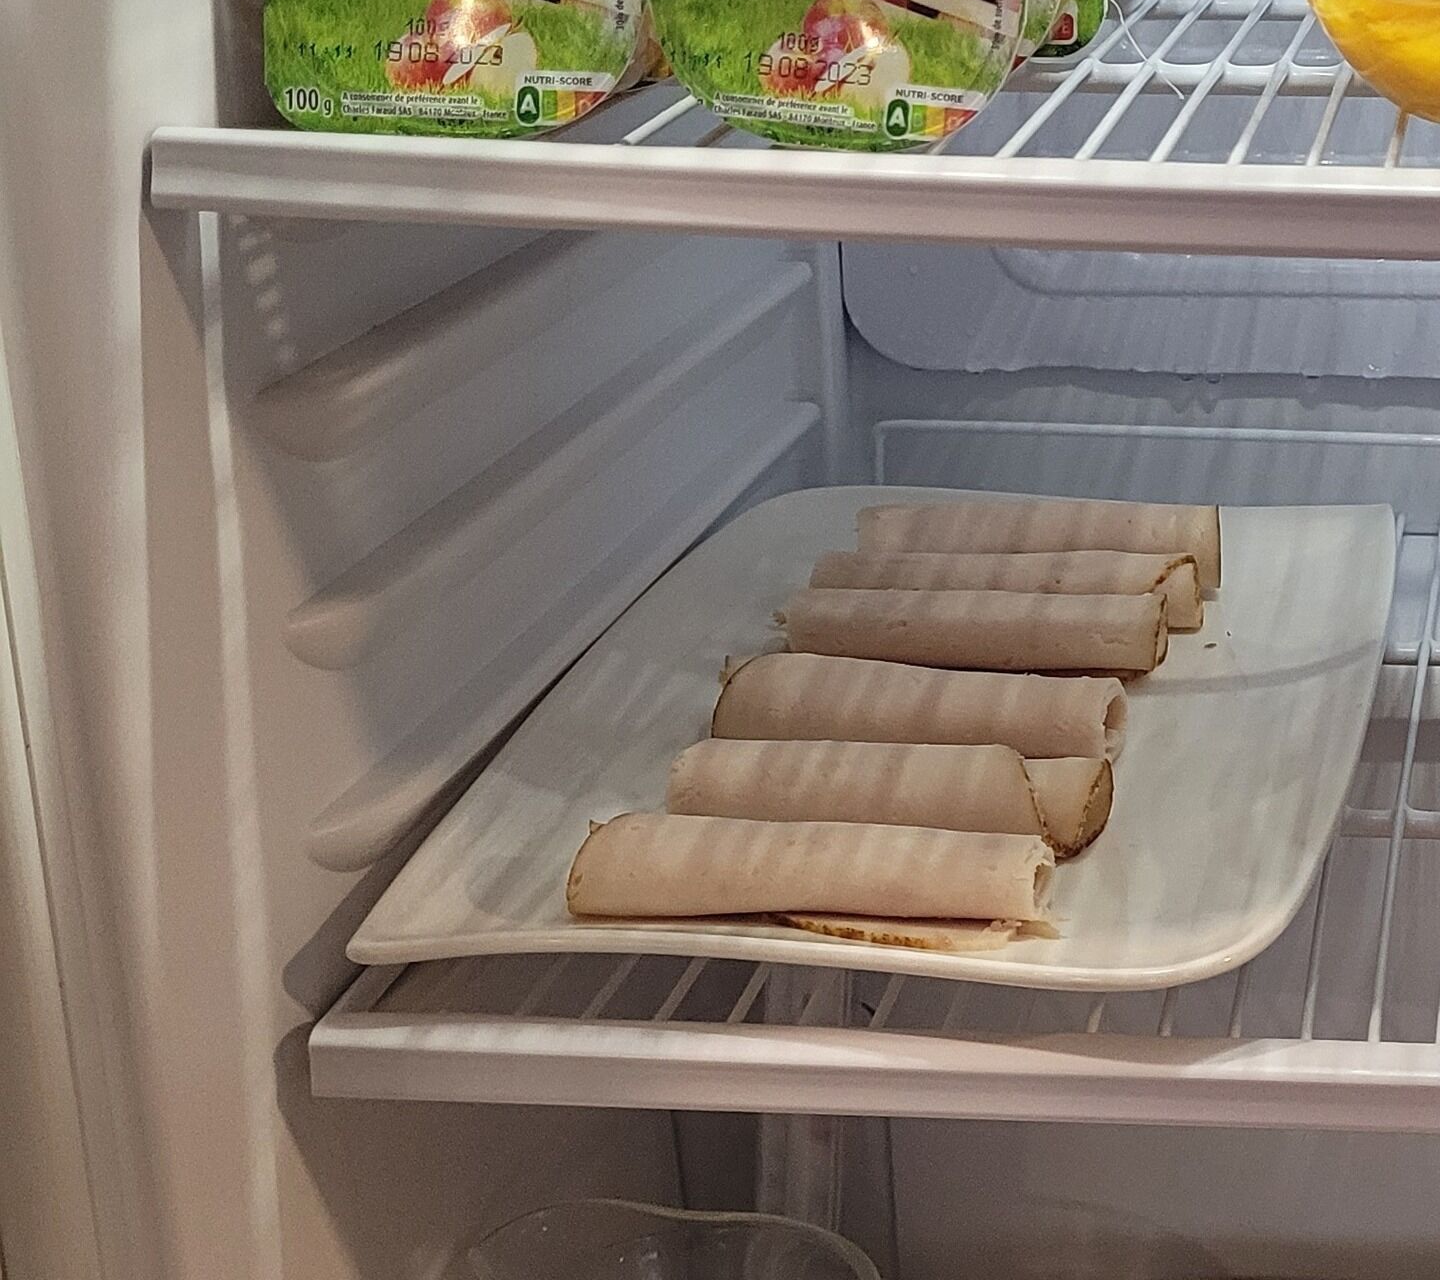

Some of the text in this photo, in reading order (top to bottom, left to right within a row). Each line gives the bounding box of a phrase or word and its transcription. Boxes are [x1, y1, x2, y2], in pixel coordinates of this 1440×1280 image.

[524, 75, 593, 87] NUTRI-SCORE
[284, 87, 333, 115] 100 g
[394, 94, 404, 103] de
[519, 96, 538, 115] A
[888, 106, 905, 128] A
